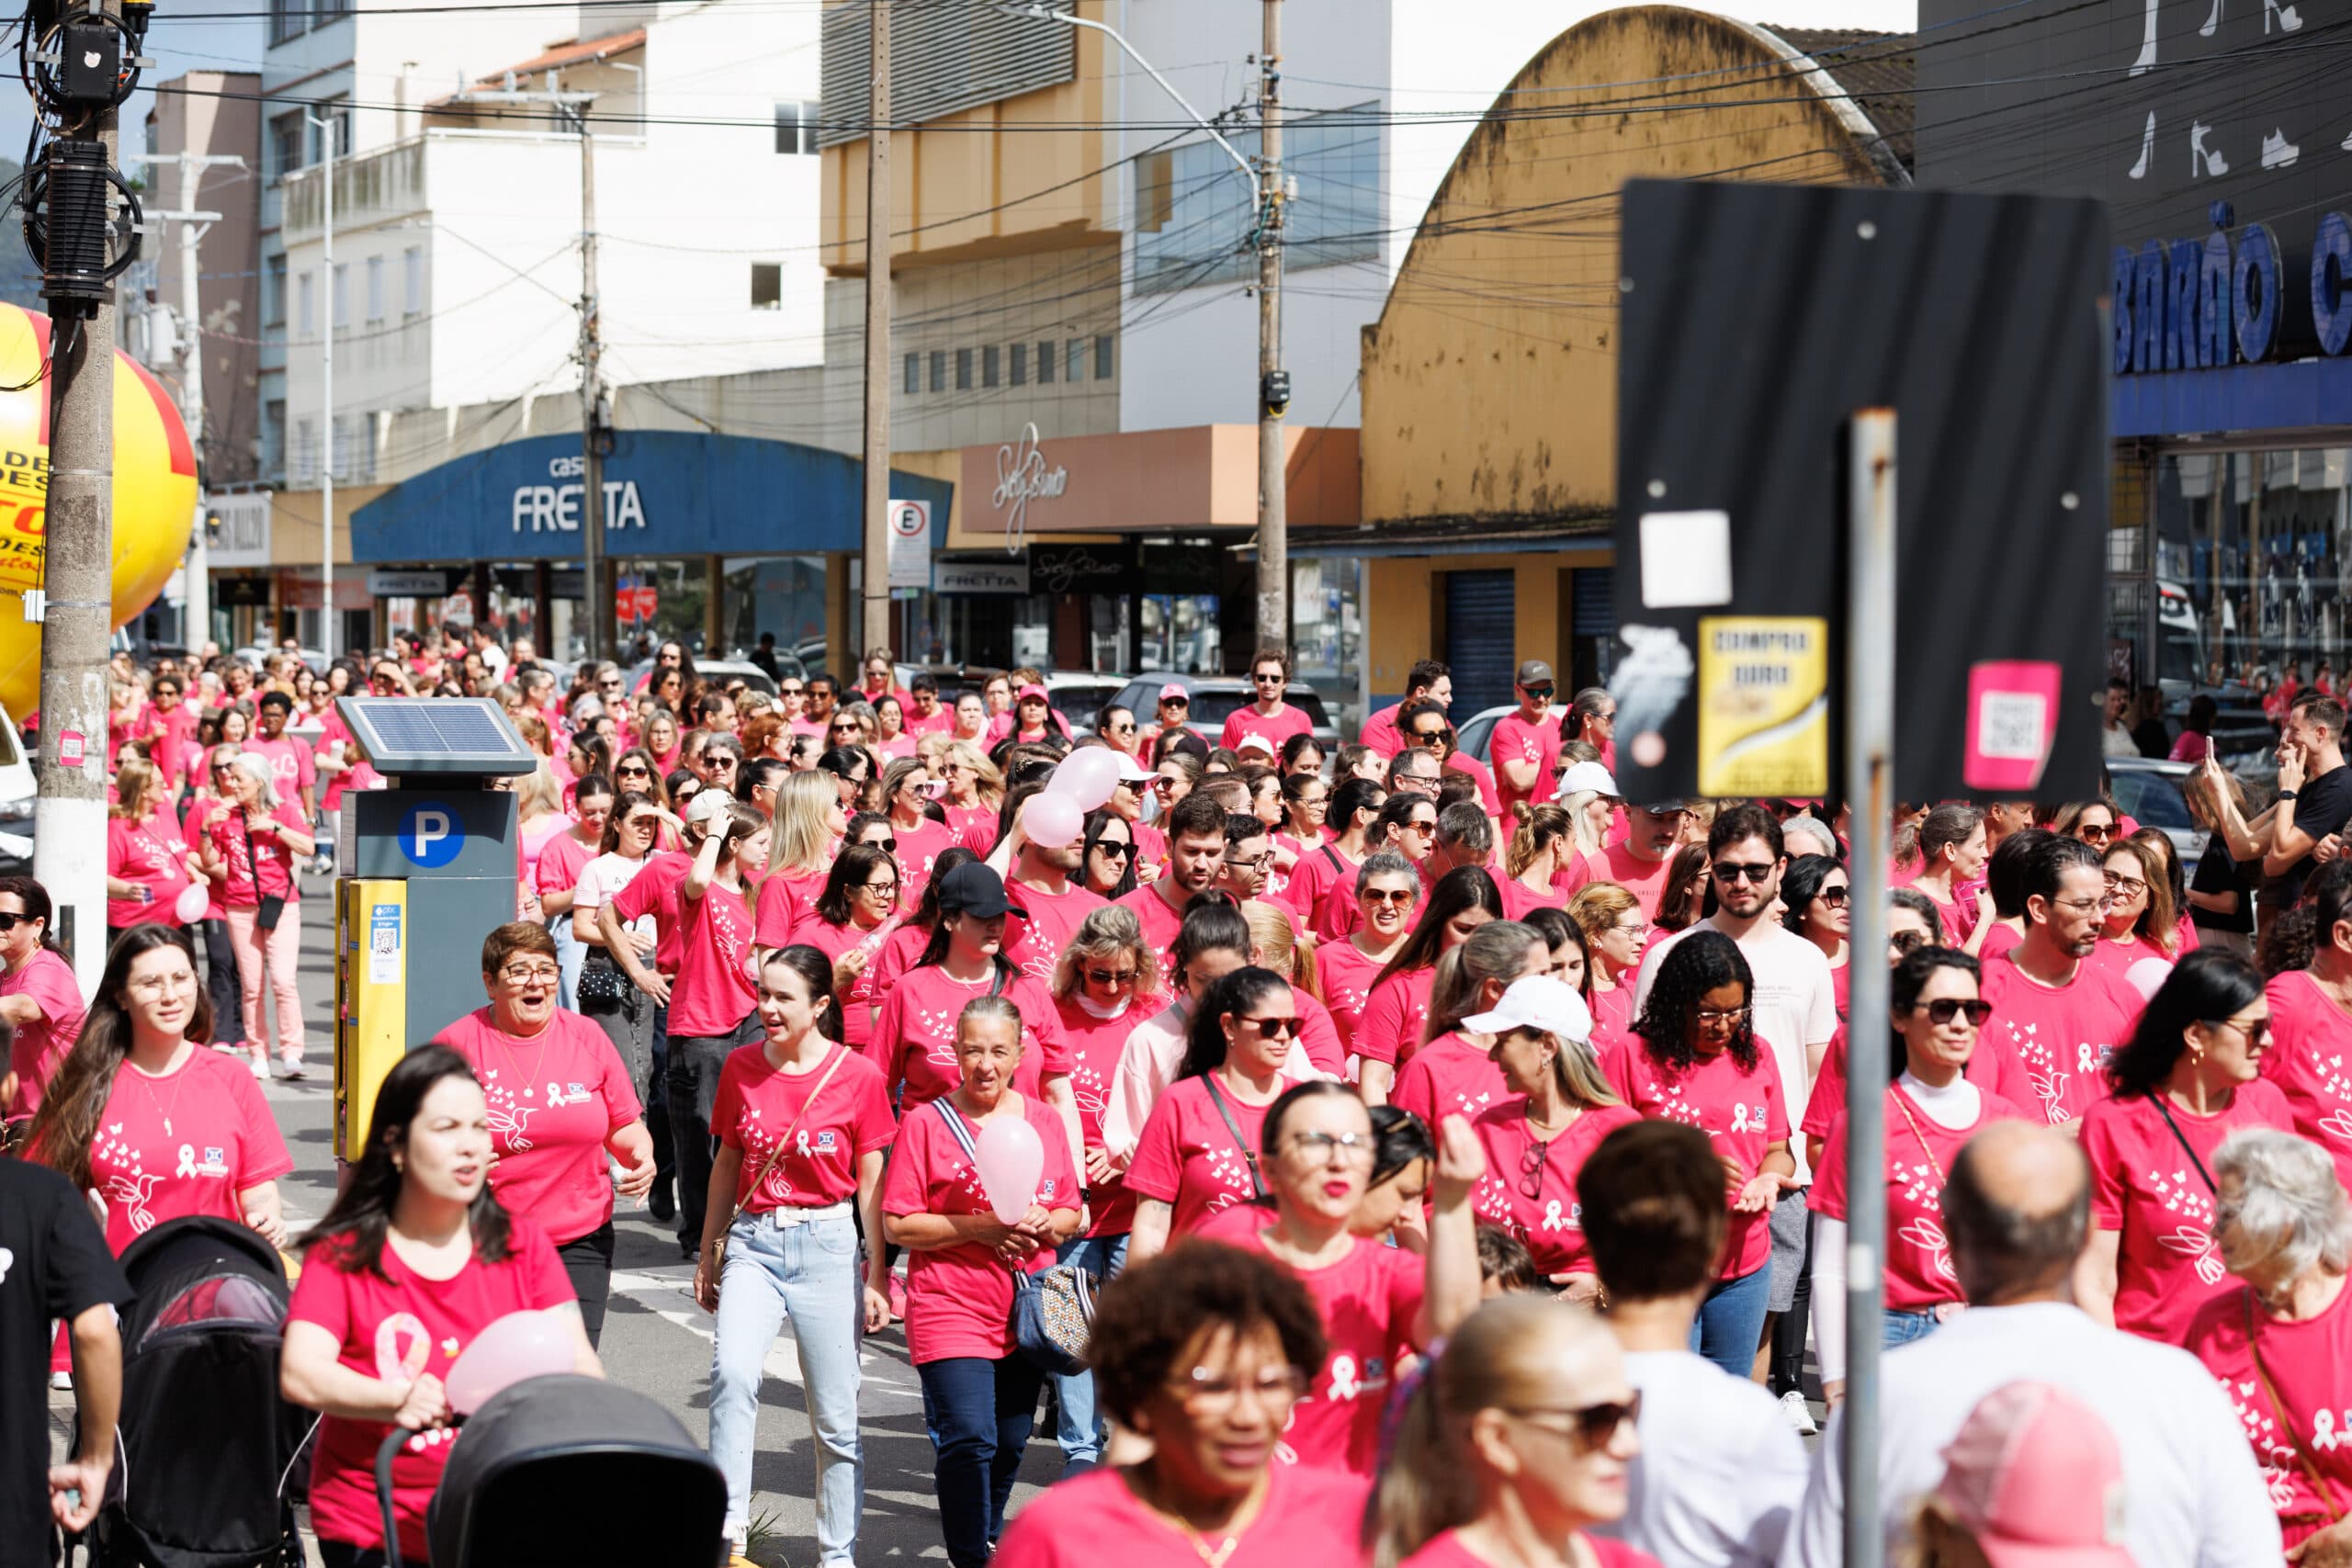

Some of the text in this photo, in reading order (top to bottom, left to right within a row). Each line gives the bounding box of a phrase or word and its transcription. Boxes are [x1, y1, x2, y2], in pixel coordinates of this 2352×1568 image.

[2113, 199, 2282, 375] BARÃO
[549, 456, 586, 479] cas
[902, 509, 914, 529] E
[944, 575, 1019, 587] FRETTA
[415, 810, 450, 857] P
